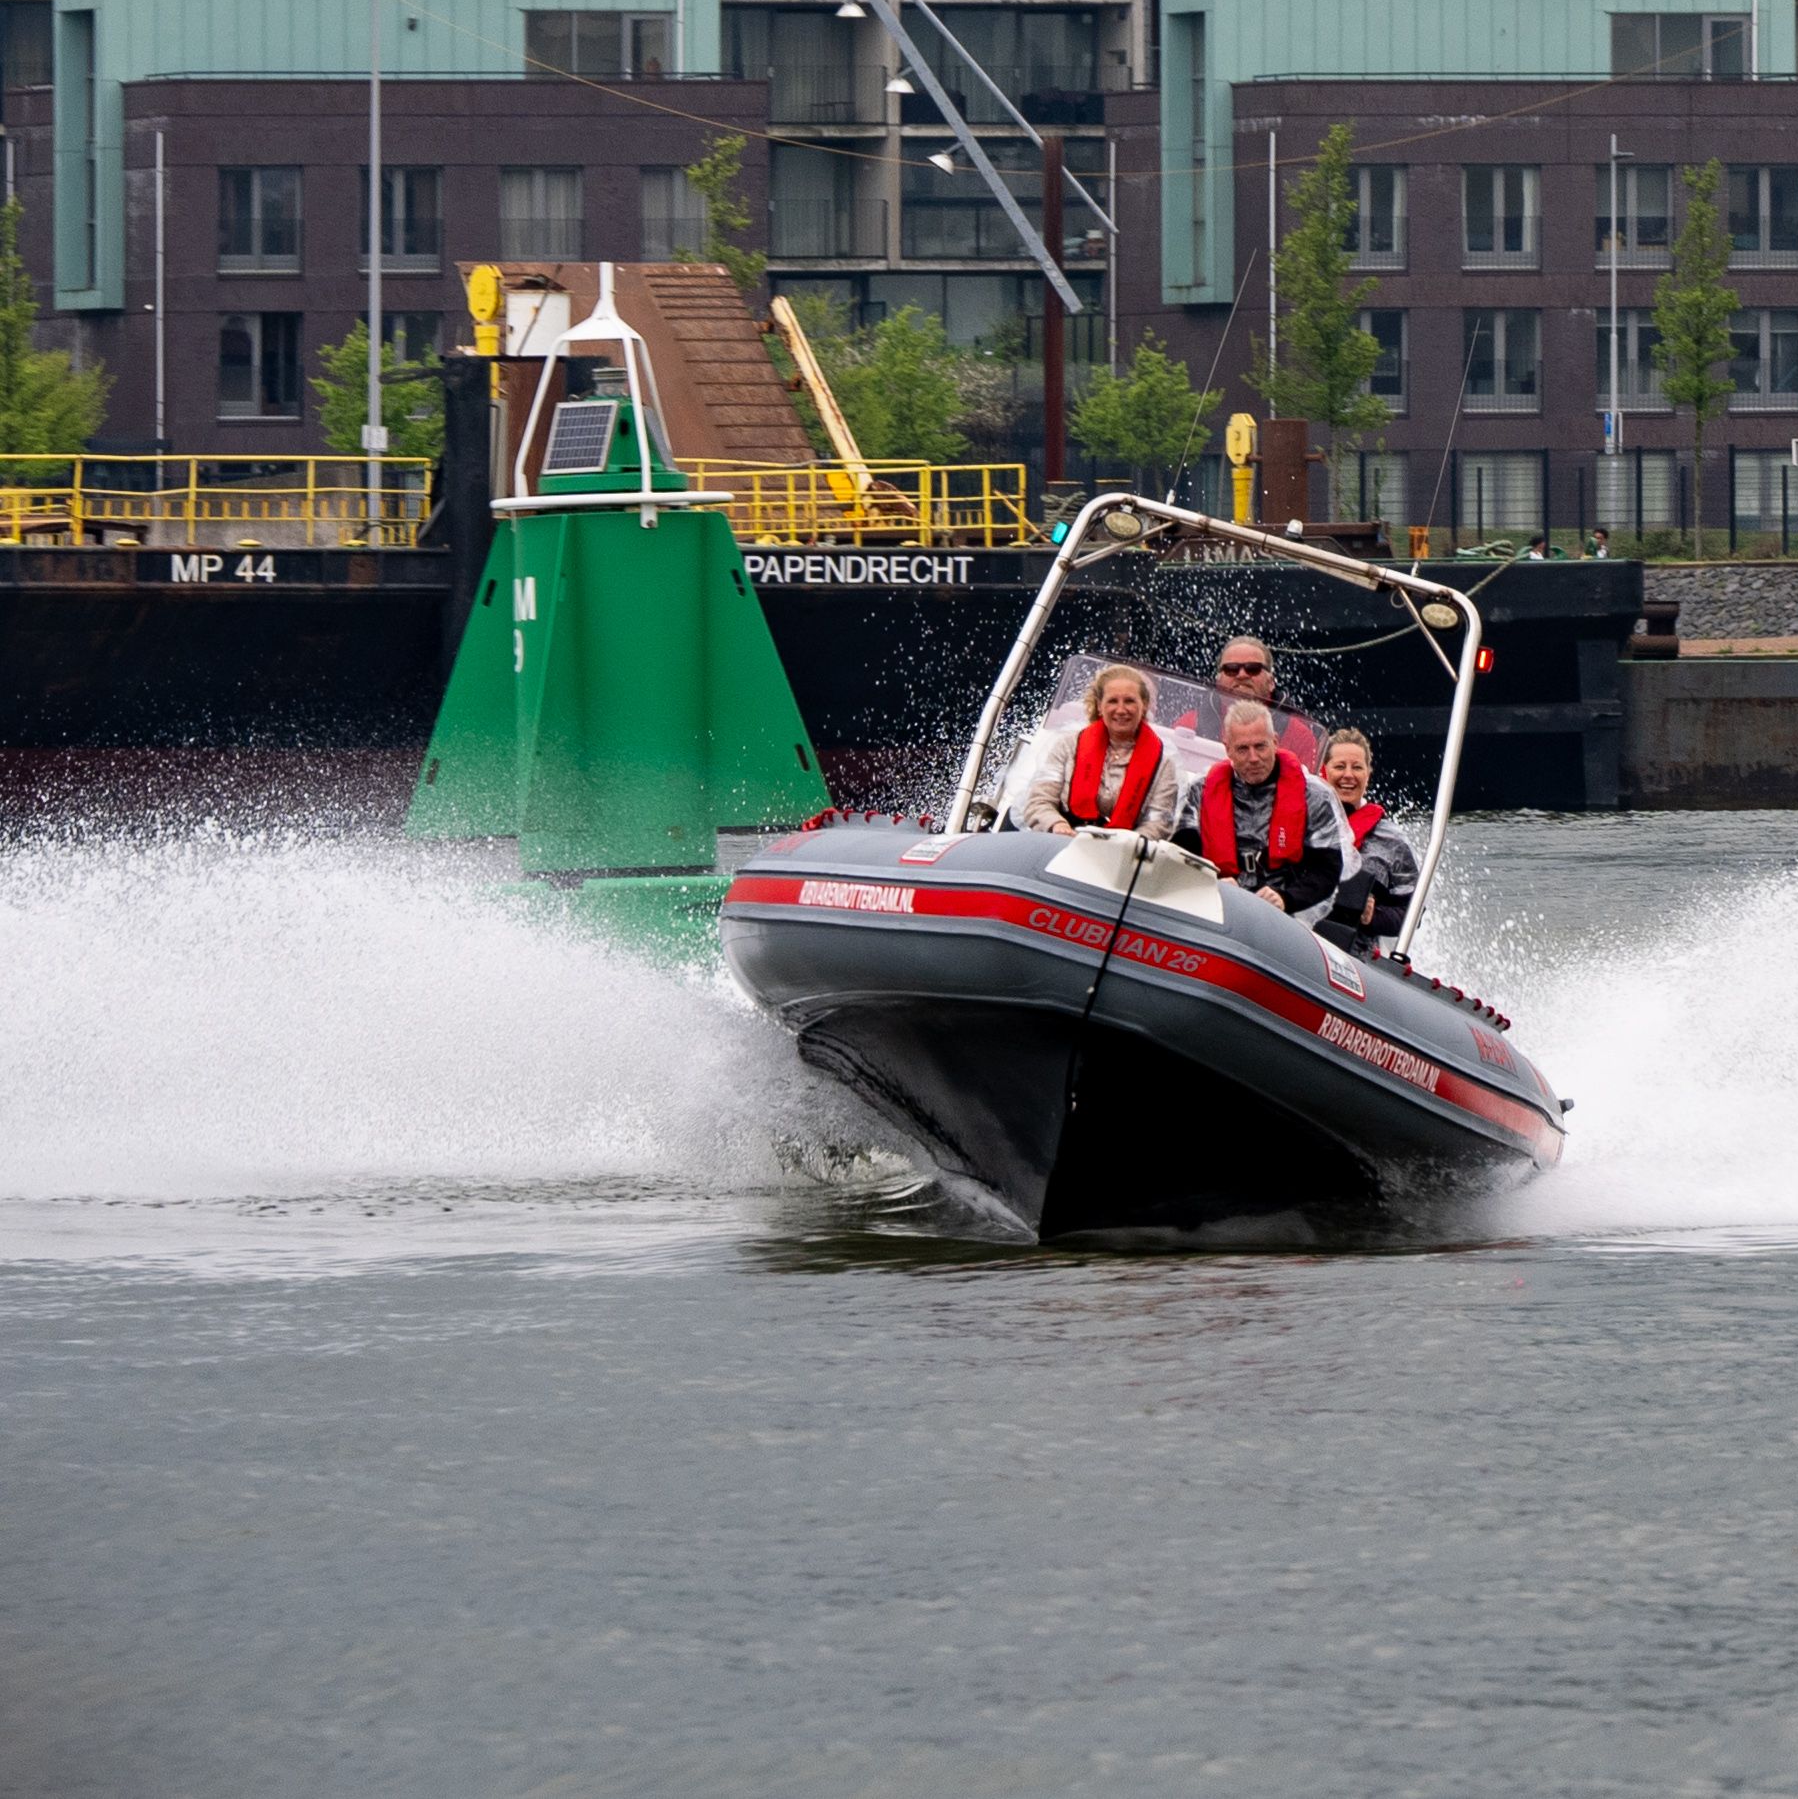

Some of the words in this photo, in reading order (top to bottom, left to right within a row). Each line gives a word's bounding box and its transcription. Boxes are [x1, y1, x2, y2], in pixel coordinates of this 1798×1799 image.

[171, 554, 223, 583] MP
[234, 554, 277, 583] 44
[744, 555, 974, 584] PAPENDRECHT
[1028, 908, 1168, 963] CLUBMAN
